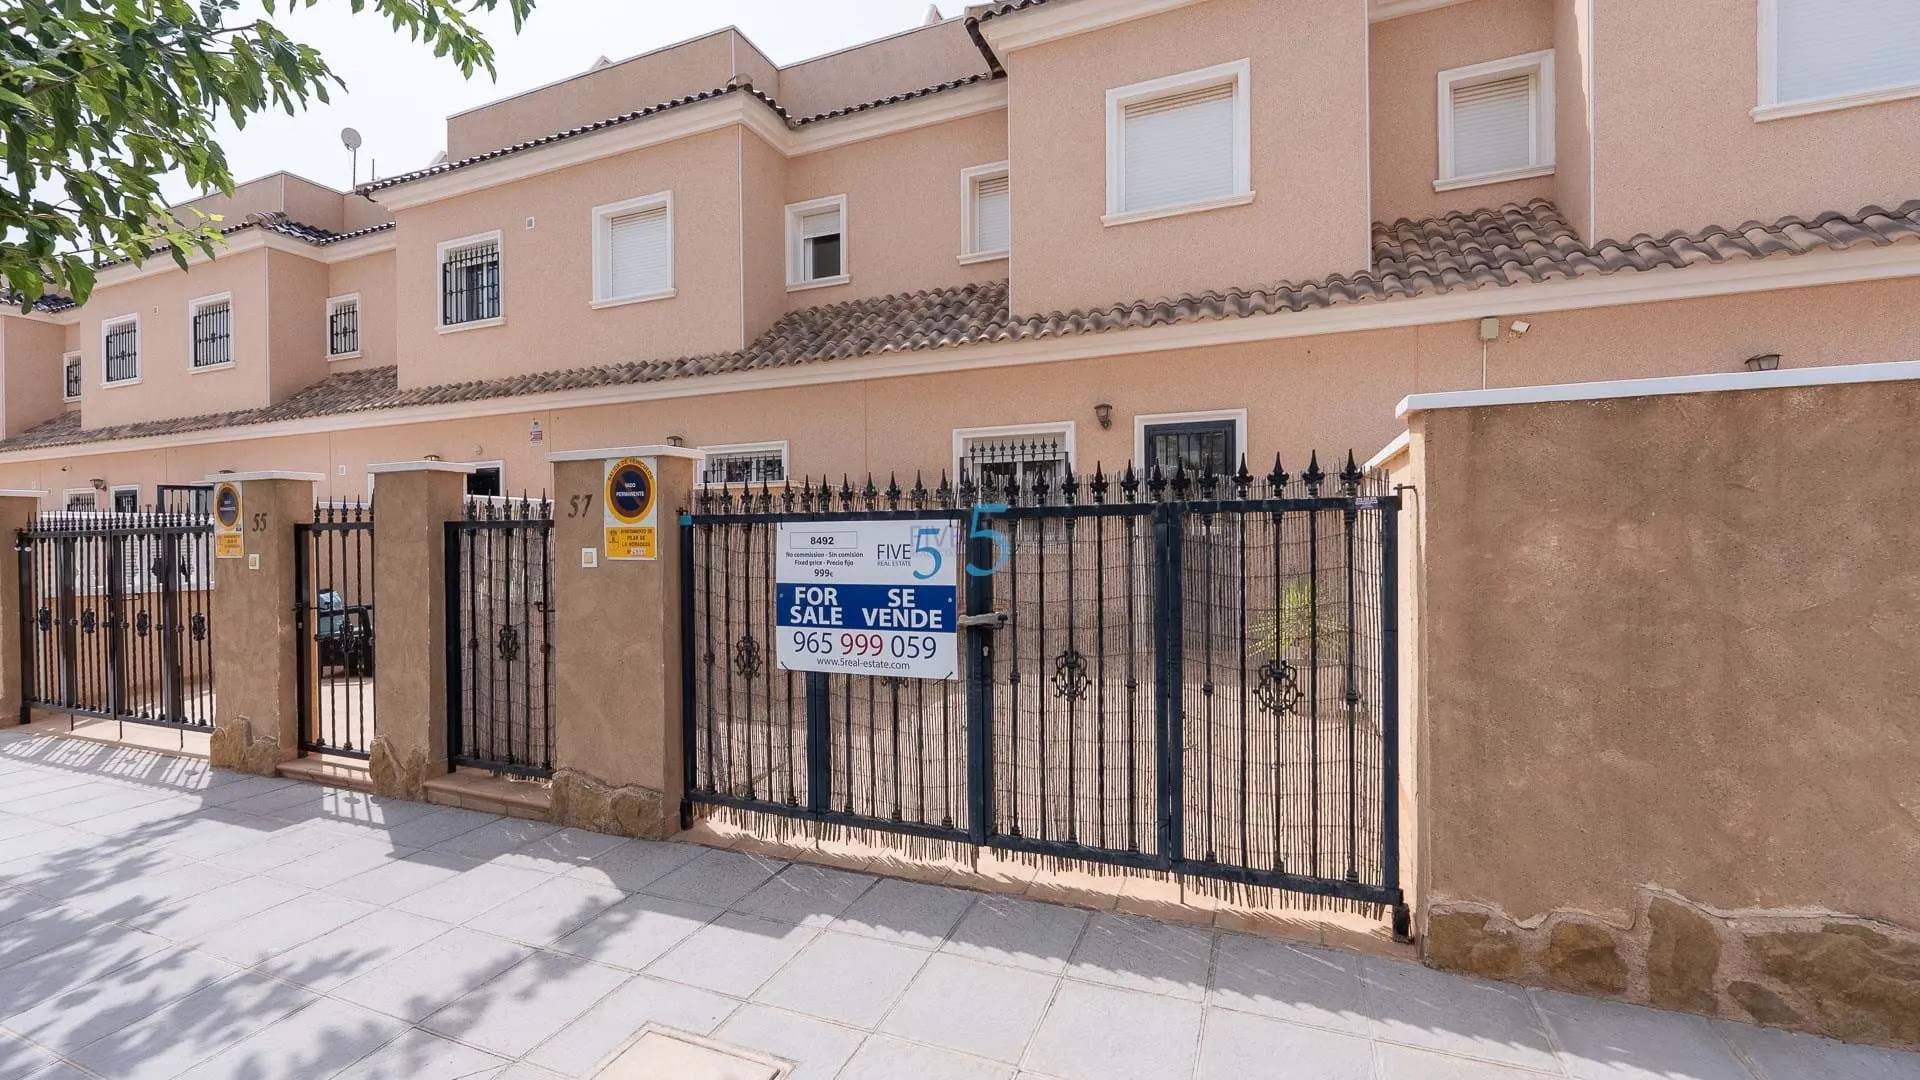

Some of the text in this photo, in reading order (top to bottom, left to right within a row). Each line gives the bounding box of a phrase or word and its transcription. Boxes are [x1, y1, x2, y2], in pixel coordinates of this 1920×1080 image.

[568, 494, 593, 519] 57
[252, 512, 267, 532] 55
[810, 536, 834, 545] 8492
[844, 559, 854, 567] fijo
[877, 528, 942, 580] FIVE 5
[795, 586, 838, 606] FOR
[887, 588, 916, 608] SE
[790, 606, 843, 626] SALE
[862, 608, 942, 629] VENDE
[793, 631, 937, 659] 965 999 059
[816, 657, 910, 670] www.5real-estate.com
